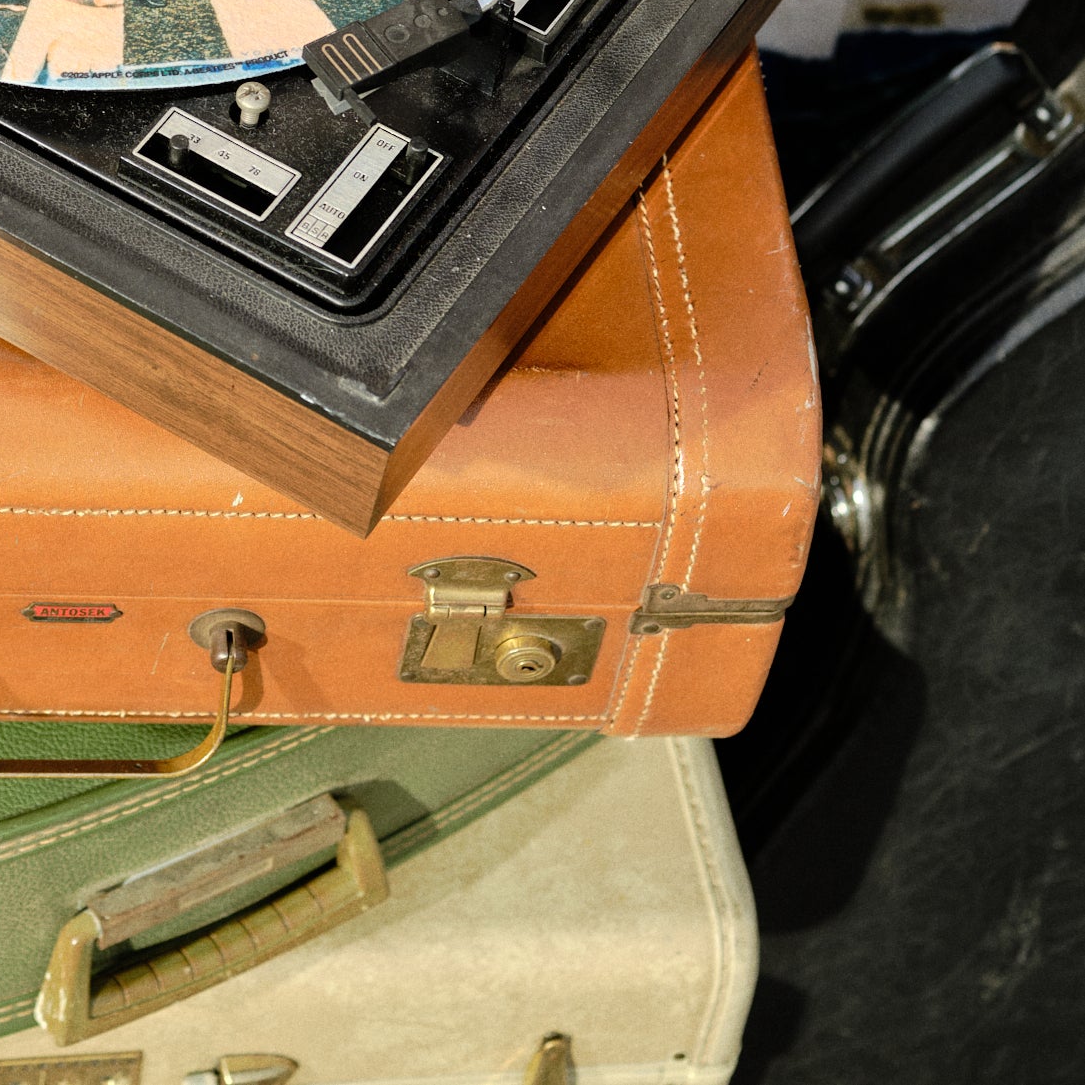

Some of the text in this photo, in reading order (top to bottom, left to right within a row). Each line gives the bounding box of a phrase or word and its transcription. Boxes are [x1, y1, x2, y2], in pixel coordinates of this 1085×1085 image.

[92, 71, 123, 79] APPLE
[245, 50, 289, 67] PRODUCT
[376, 139, 396, 152] OFF
[217, 149, 231, 161] 45
[248, 165, 262, 177] 78
[353, 171, 369, 183] ON
[319, 203, 346, 220] AUTO
[39, 607, 106, 617] ANTOSEK
